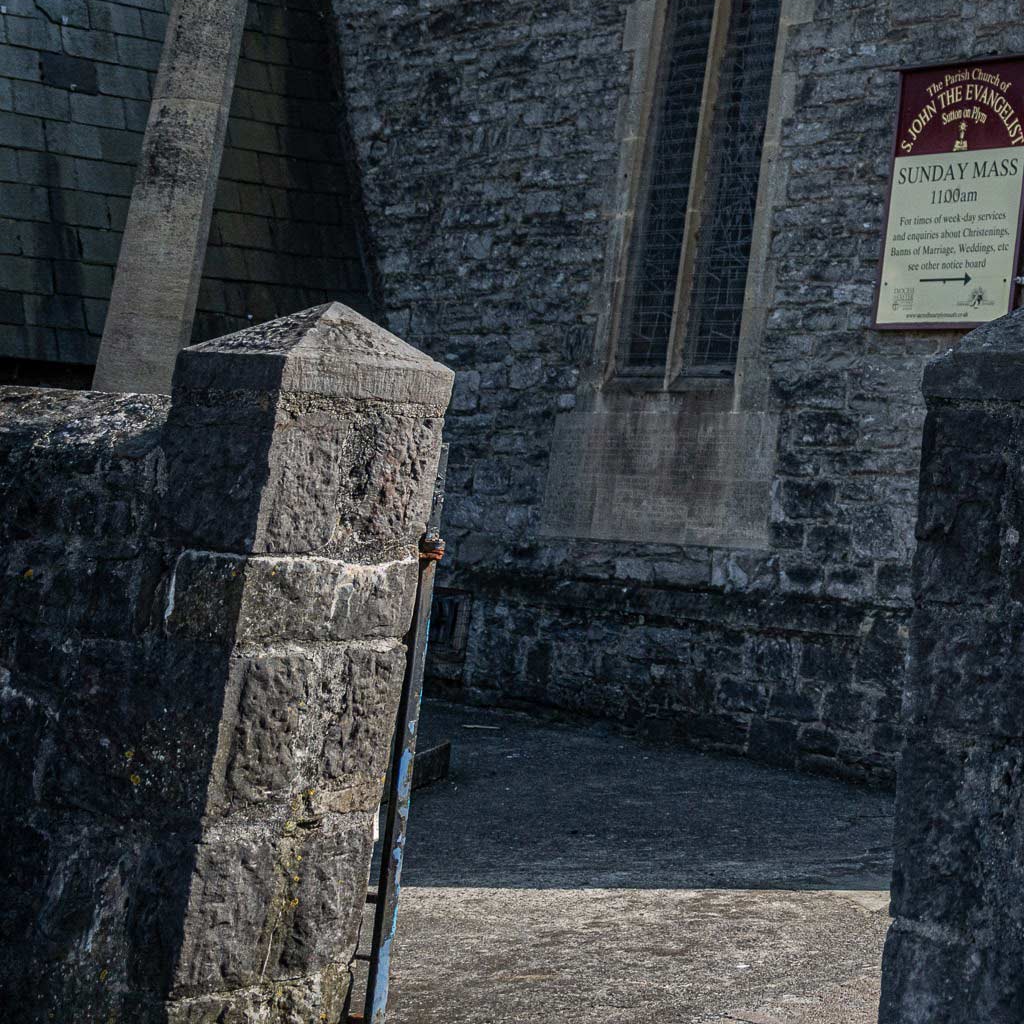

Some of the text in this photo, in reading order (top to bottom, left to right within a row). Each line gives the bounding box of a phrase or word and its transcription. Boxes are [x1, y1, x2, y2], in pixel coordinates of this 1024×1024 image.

[926, 68, 1012, 96] The Parish Church of
[901, 84, 1024, 153] S. JOHN THE EVANGELIST
[942, 106, 988, 125] Sutton on Plym
[898, 158, 1018, 185] SUNDAY MASS
[900, 210, 1006, 226] For times of week-day services
[892, 232, 906, 241] and
[907, 231, 939, 243] enquiries
[940, 229, 961, 239] about
[890, 247, 912, 256] Banns
[912, 246, 921, 256] of
[998, 243, 1008, 251] etc
[908, 259, 986, 271] see other notice board
